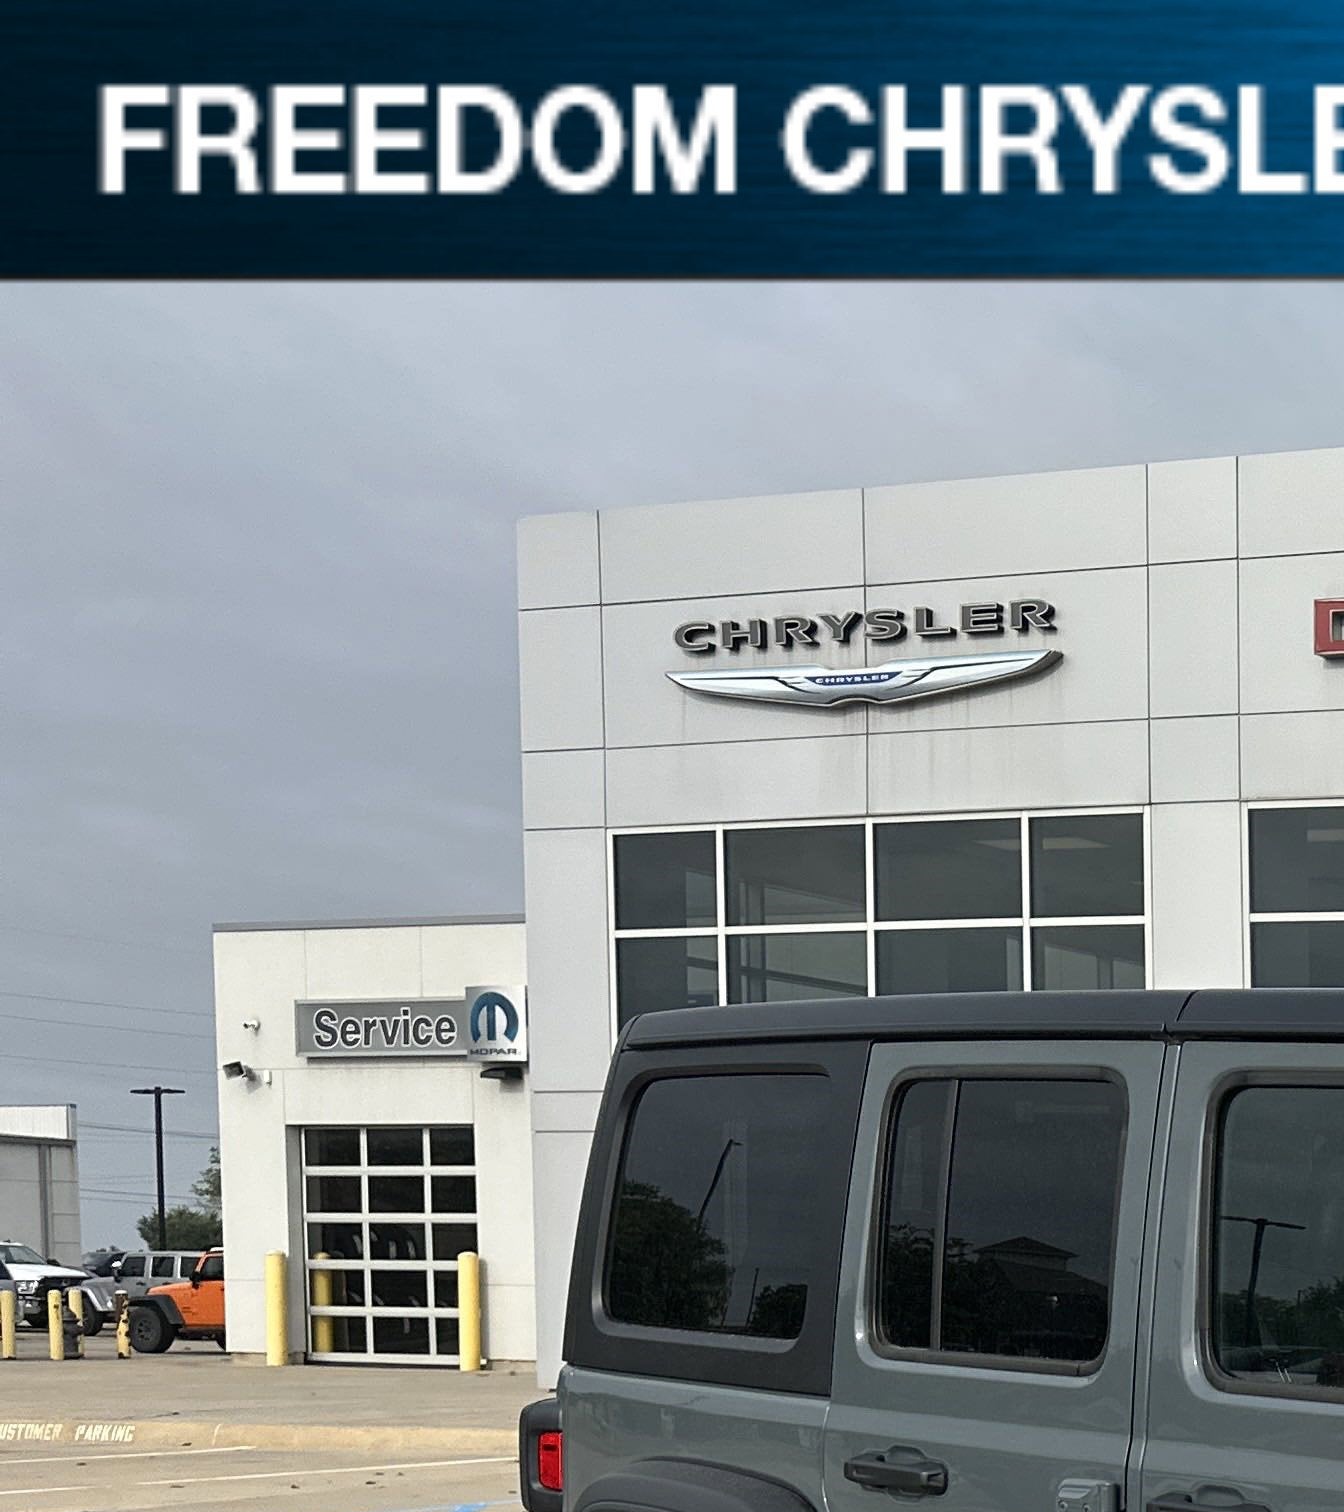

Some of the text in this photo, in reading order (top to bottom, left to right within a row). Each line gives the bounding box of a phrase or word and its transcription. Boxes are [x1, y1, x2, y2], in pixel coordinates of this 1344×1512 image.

[672, 598, 1058, 653] CHRYSLER
[814, 673, 890, 686] CHRYSLER
[313, 1008, 458, 1048] Service
[470, 1048, 518, 1056] MOPAR
[75, 1424, 135, 1442] PARKING
